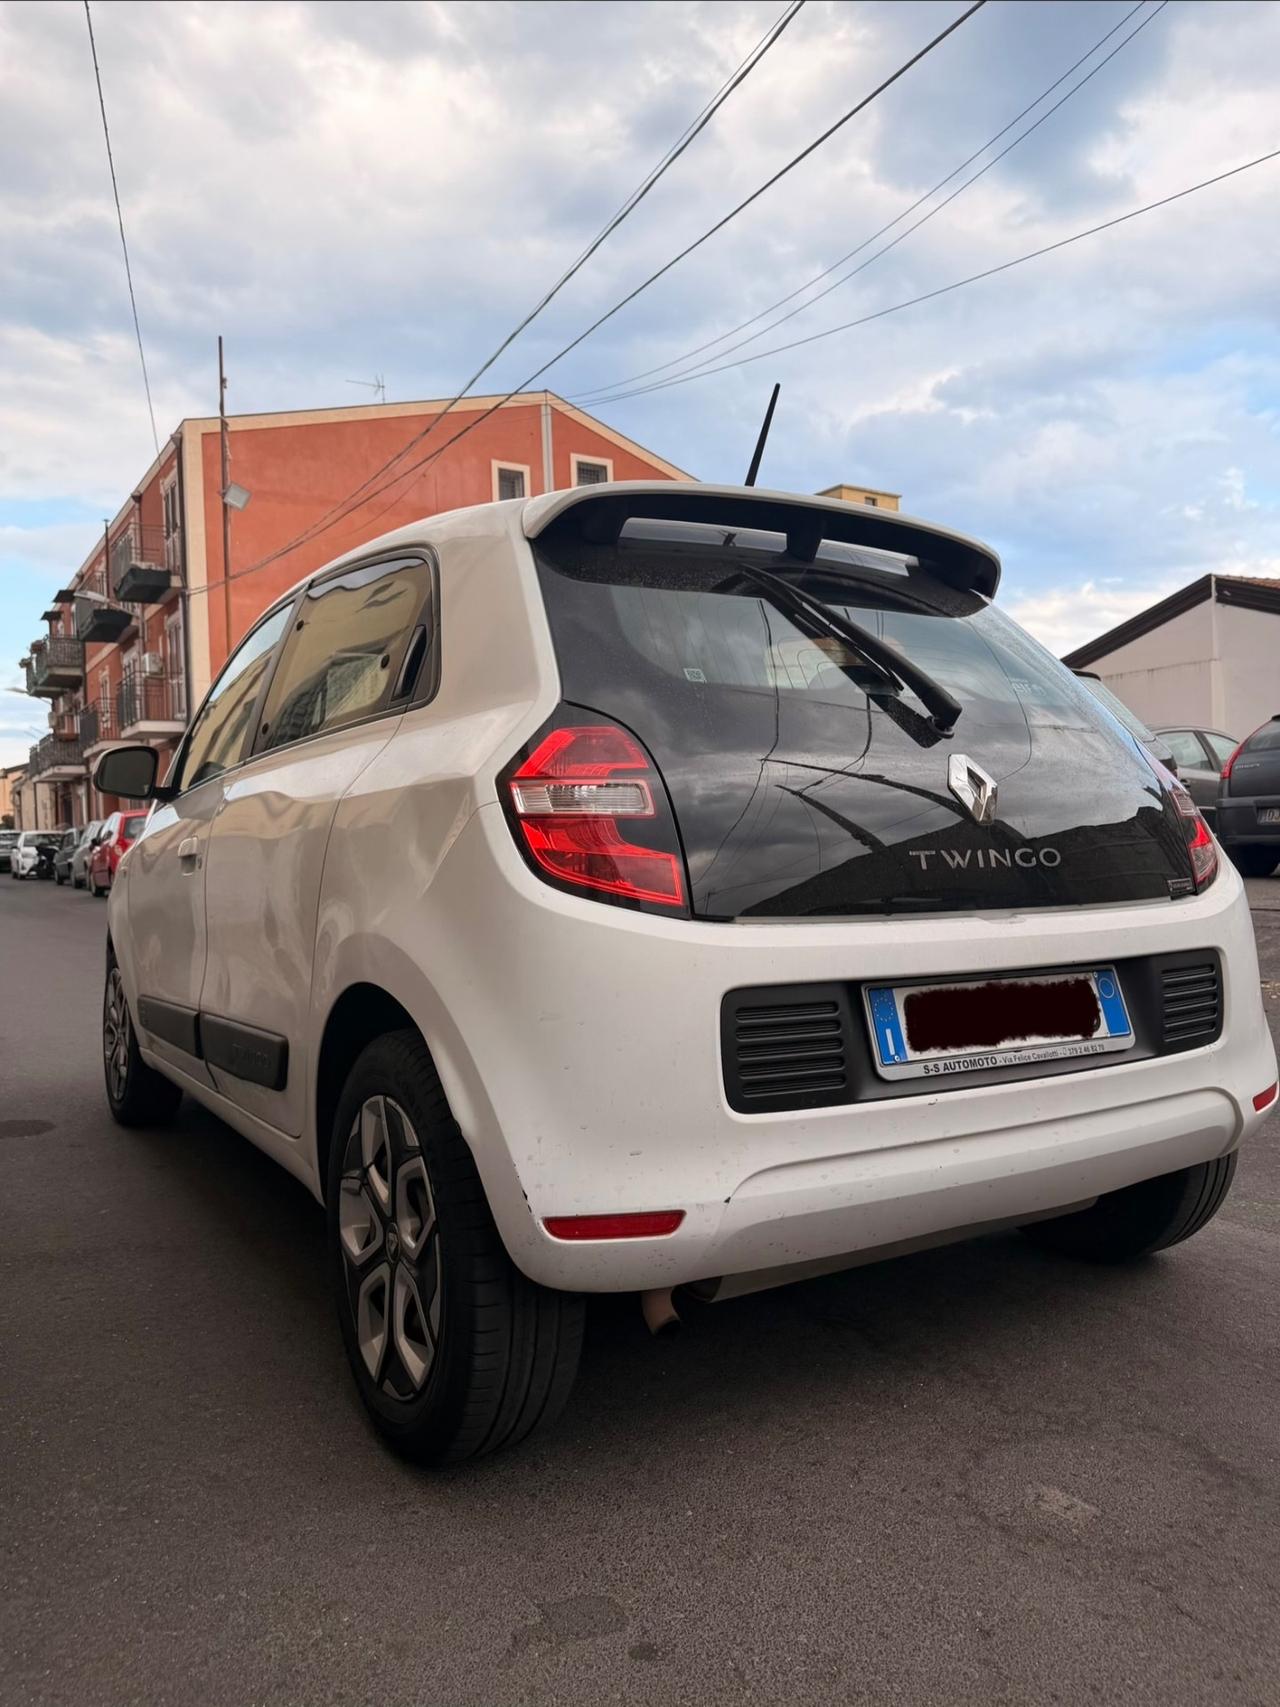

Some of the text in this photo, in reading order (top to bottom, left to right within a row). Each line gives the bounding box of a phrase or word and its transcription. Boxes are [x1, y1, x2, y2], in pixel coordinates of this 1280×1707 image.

[909, 847, 1061, 870] TWINGO
[923, 1063, 940, 1075] S-S
[943, 1055, 998, 1072] AUTOMOTO
[1002, 1054, 1013, 1063] Via
[1014, 1052, 1031, 1062] Felice
